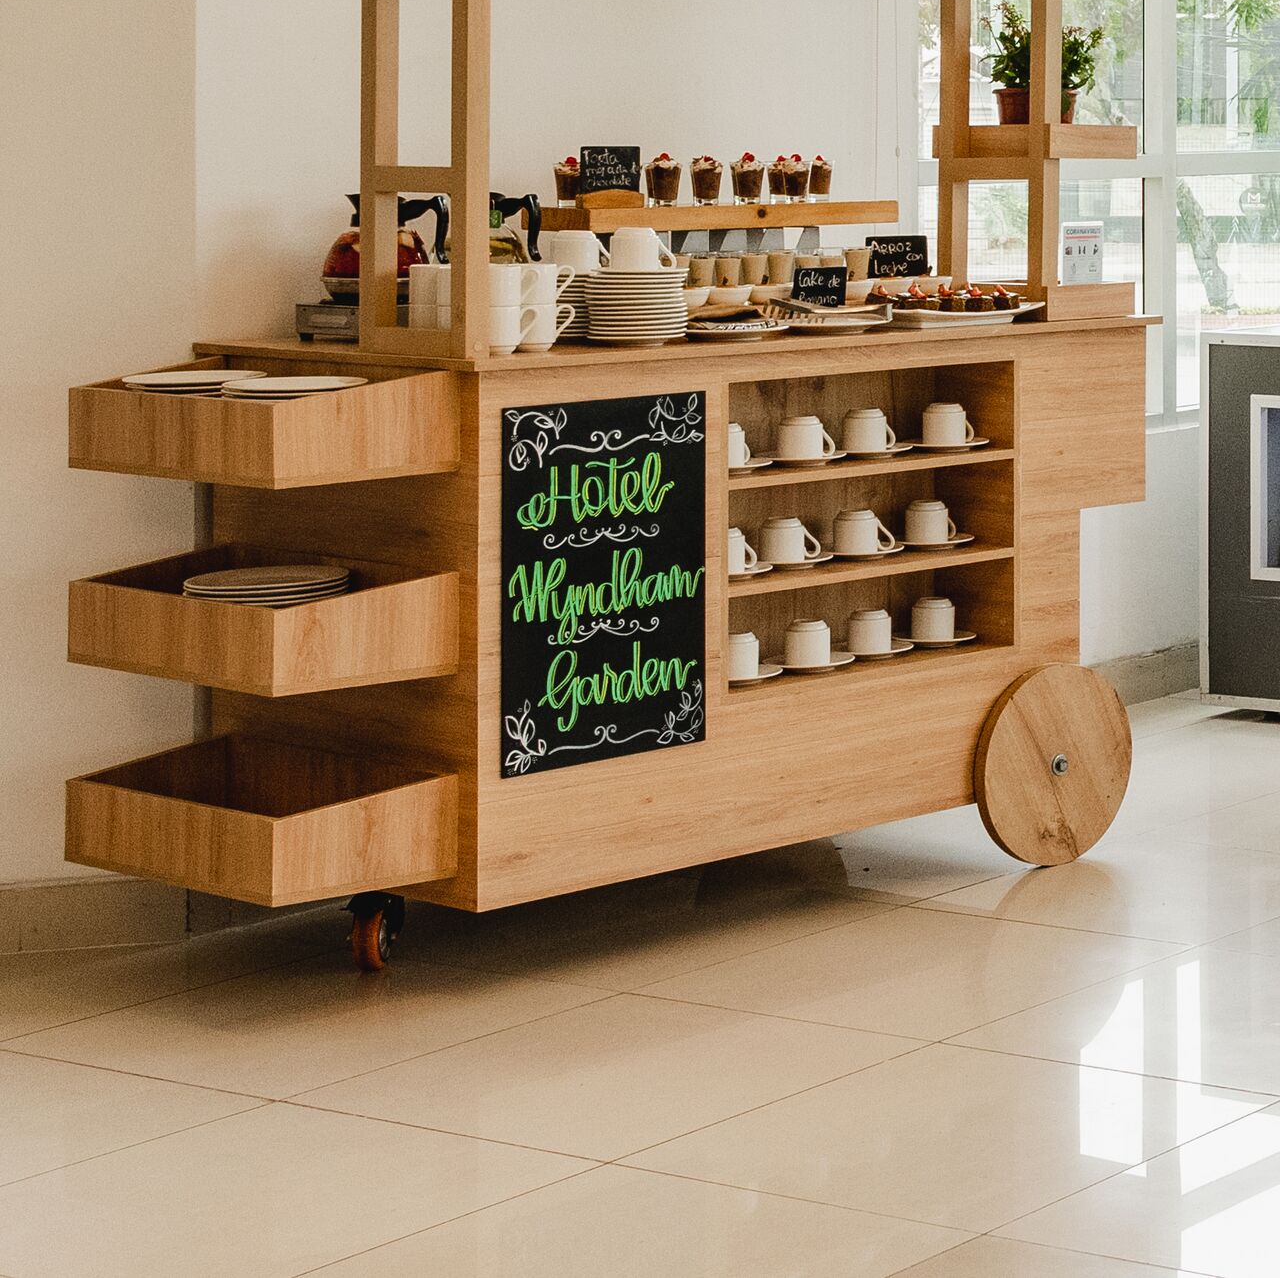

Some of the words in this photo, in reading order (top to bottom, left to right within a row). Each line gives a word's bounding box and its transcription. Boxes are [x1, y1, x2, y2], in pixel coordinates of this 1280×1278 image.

[517, 451, 675, 528] Hotel
[508, 546, 705, 645] Wyndham
[537, 640, 698, 733] Garden
